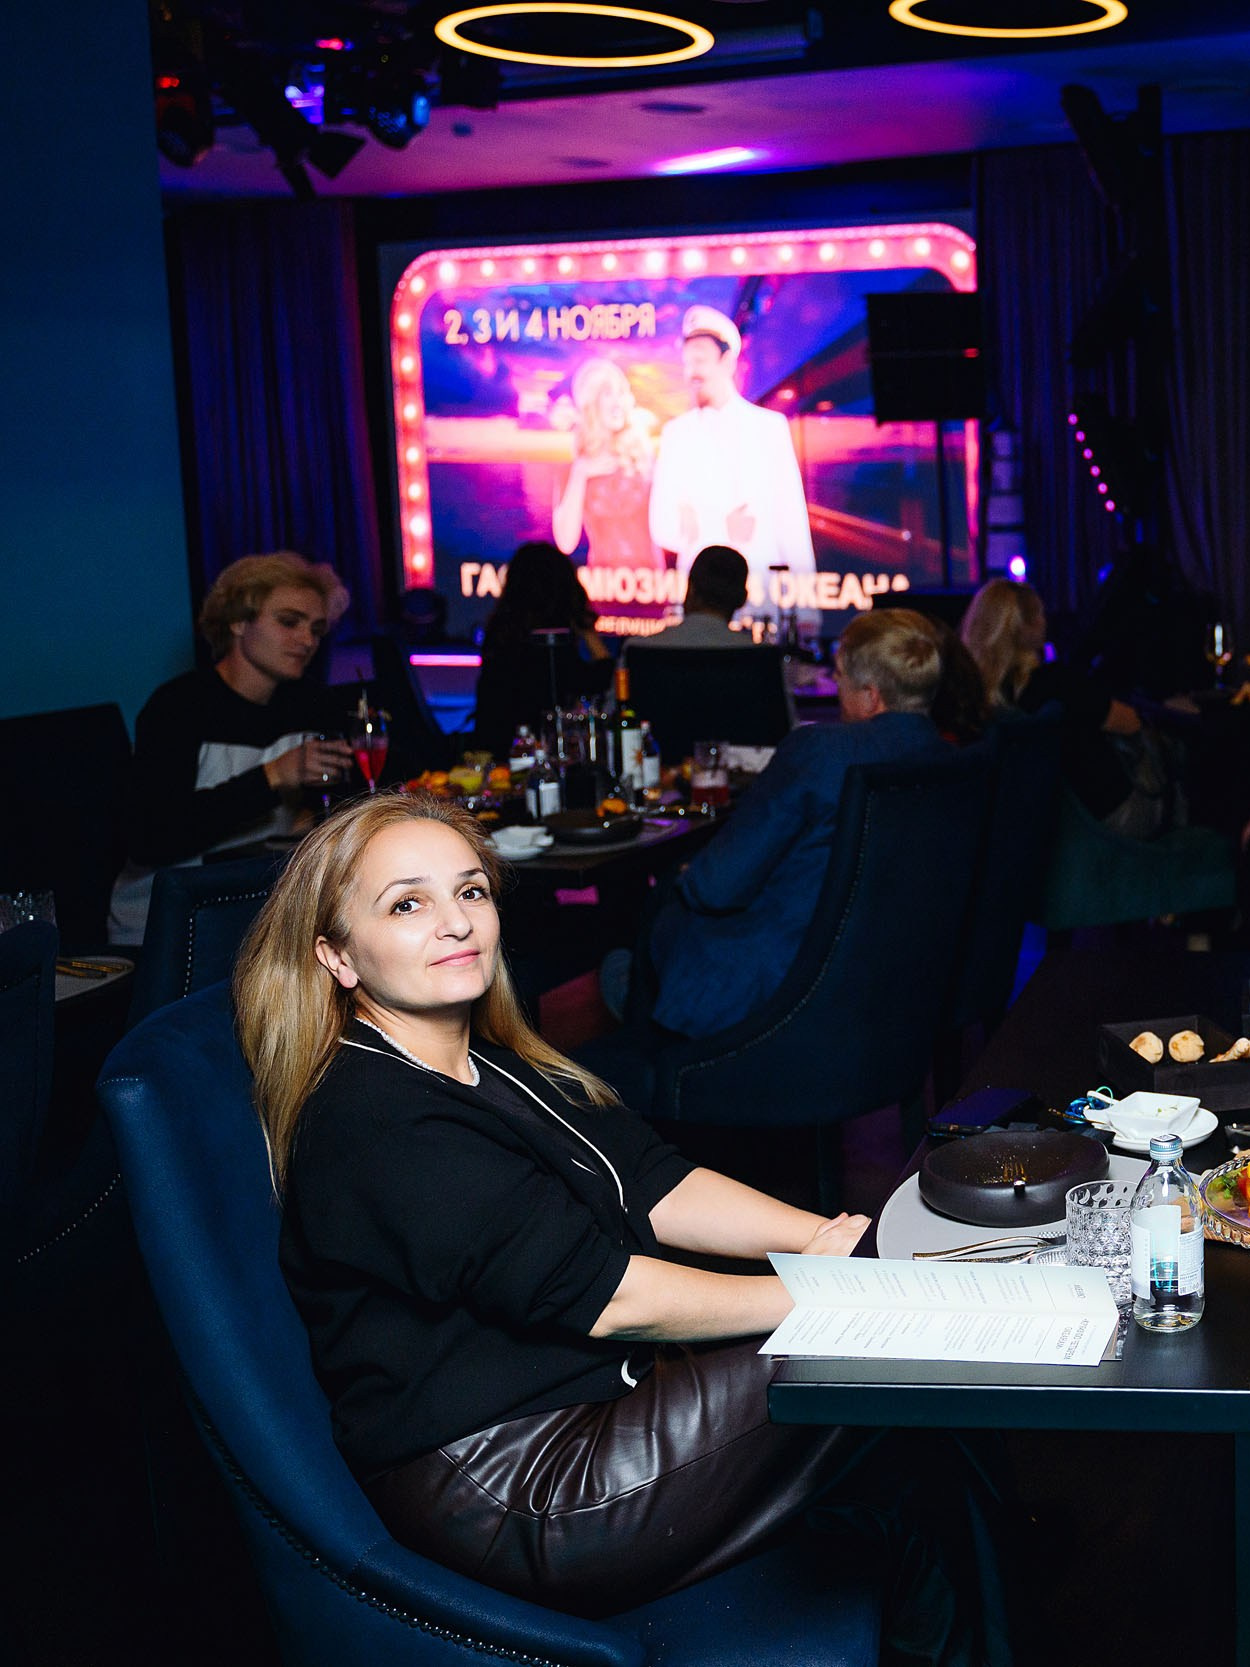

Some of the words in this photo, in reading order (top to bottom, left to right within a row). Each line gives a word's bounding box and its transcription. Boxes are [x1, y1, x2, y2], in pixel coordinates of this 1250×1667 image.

[443, 309, 469, 345] 2,
[472, 308, 492, 344] 3
[495, 308, 520, 342] И
[524, 307, 544, 342] 4
[547, 302, 656, 341] НОЯБРЯ
